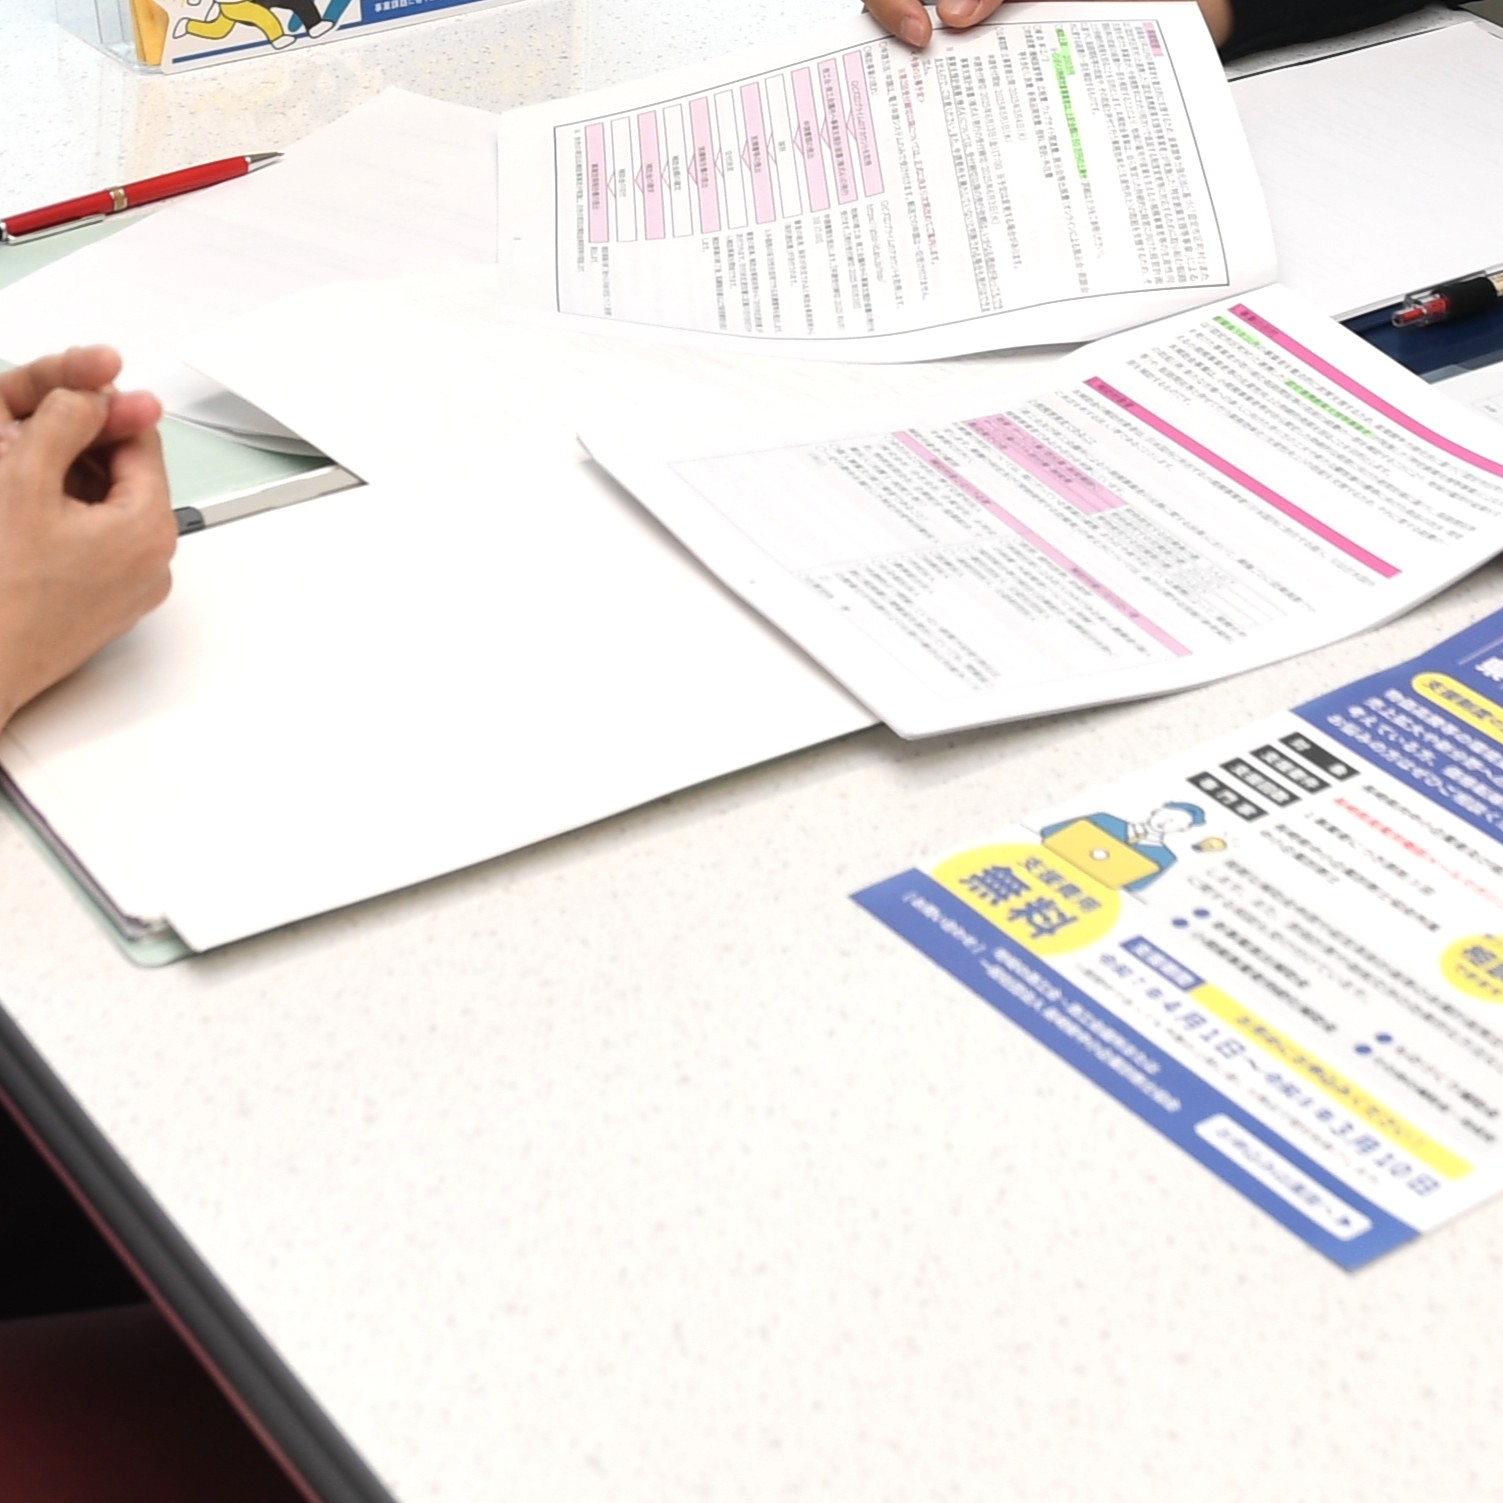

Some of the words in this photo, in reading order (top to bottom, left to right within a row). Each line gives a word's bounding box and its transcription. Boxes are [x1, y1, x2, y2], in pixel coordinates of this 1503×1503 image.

[956, 861, 1083, 942] 無料
[1016, 855, 1102, 914] 支援費用
